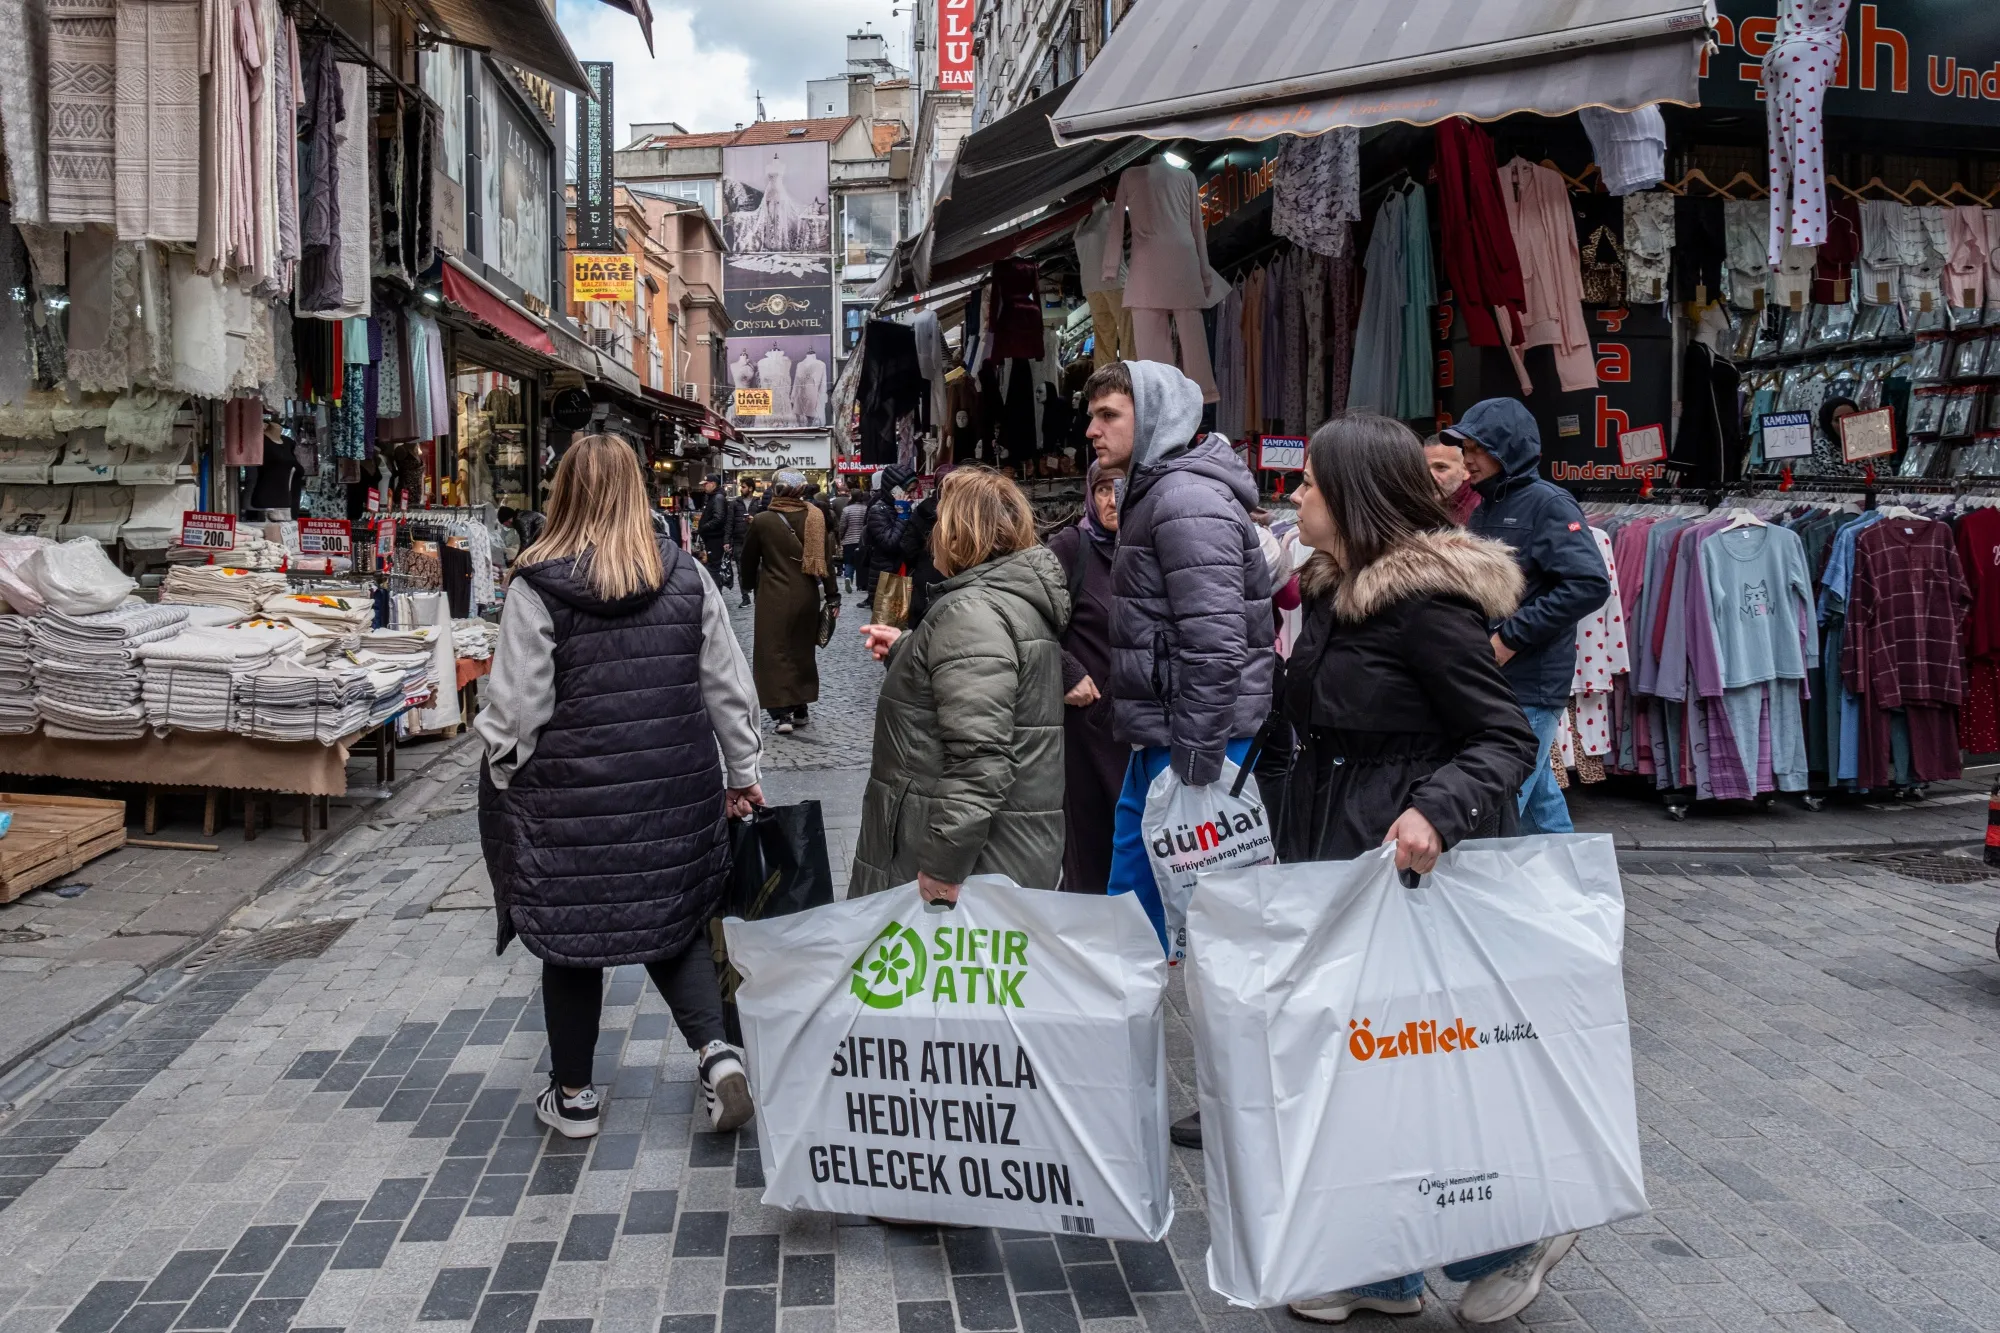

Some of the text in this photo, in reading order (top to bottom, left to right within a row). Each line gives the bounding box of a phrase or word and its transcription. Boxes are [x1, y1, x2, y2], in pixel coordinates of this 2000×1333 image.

[941, 70, 974, 84] HAN
[1928, 55, 2000, 100] Und
[507, 121, 541, 182] ZEBRA
[575, 262, 633, 272] HAC&
[575, 271, 634, 282] UMRE
[734, 318, 821, 331] CRYSTAL DANTEL
[1763, 413, 1809, 427] KAMPANYA
[1262, 438, 1305, 448] KAMPANYA
[1621, 431, 1653, 460] 300
[774, 454, 817, 467] DANTEL
[1551, 460, 1666, 481] Underwear
[203, 530, 225, 547] 200
[321, 536, 343, 551] 300
[1237, 835, 1272, 854] Markası
[933, 926, 1029, 966] SIFIR
[931, 965, 1028, 1009] ATIK
[1349, 1017, 1480, 1062] Özdilek
[1479, 1031, 1491, 1045] ev
[830, 1036, 1038, 1090] SIFIR ATIKLA
[845, 1087, 1021, 1146] HEDİYENİZ
[808, 1144, 1085, 1208] GELECEK OLSUN.
